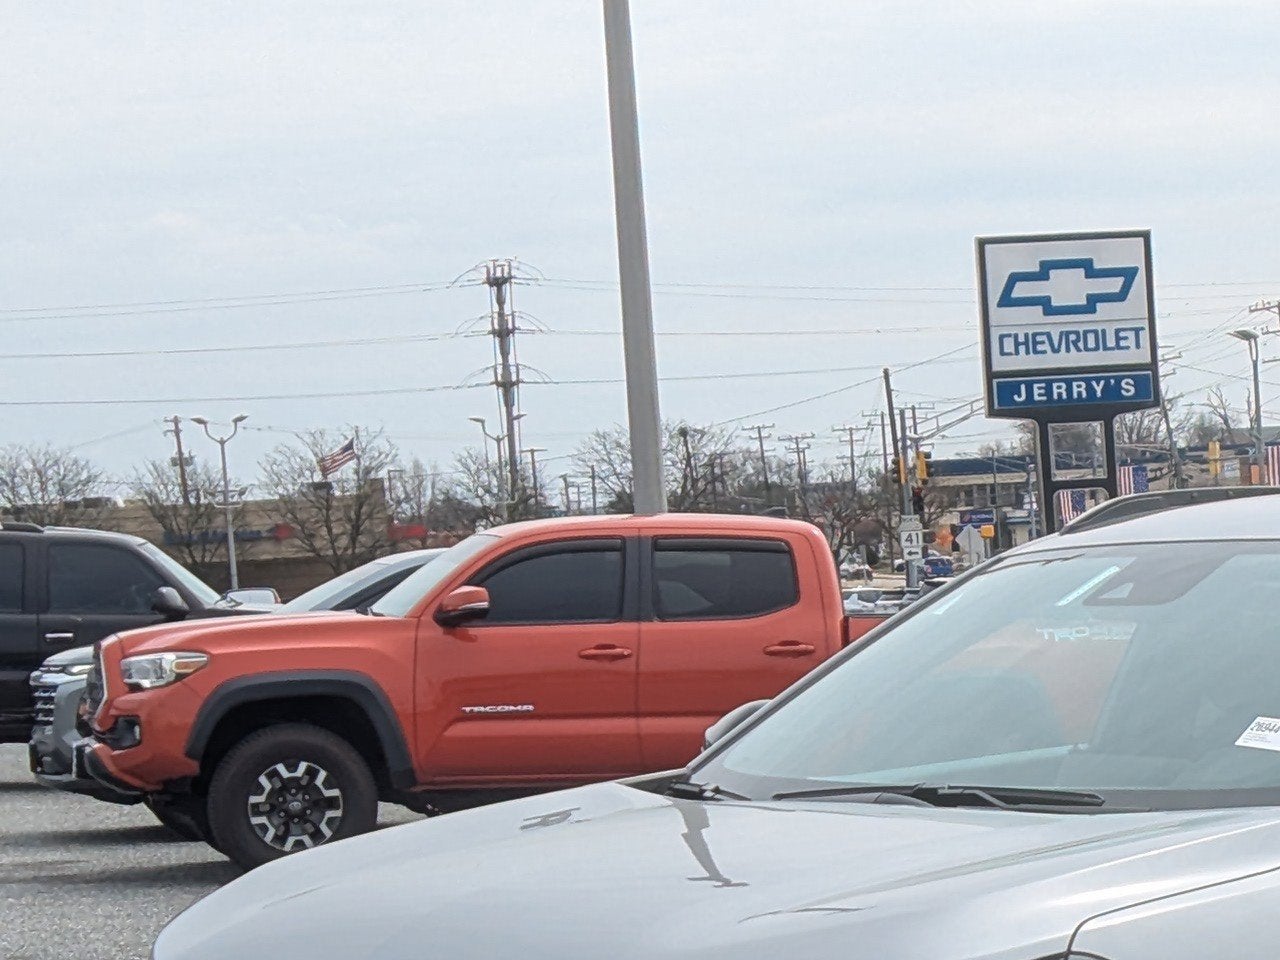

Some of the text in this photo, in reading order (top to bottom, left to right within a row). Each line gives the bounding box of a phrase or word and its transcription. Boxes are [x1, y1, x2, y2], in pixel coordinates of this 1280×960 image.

[998, 327, 1146, 357] CHEVROLET
[1013, 378, 1136, 402] JERRY'S
[905, 532, 920, 544] 41
[461, 705, 535, 713] TACOMA
